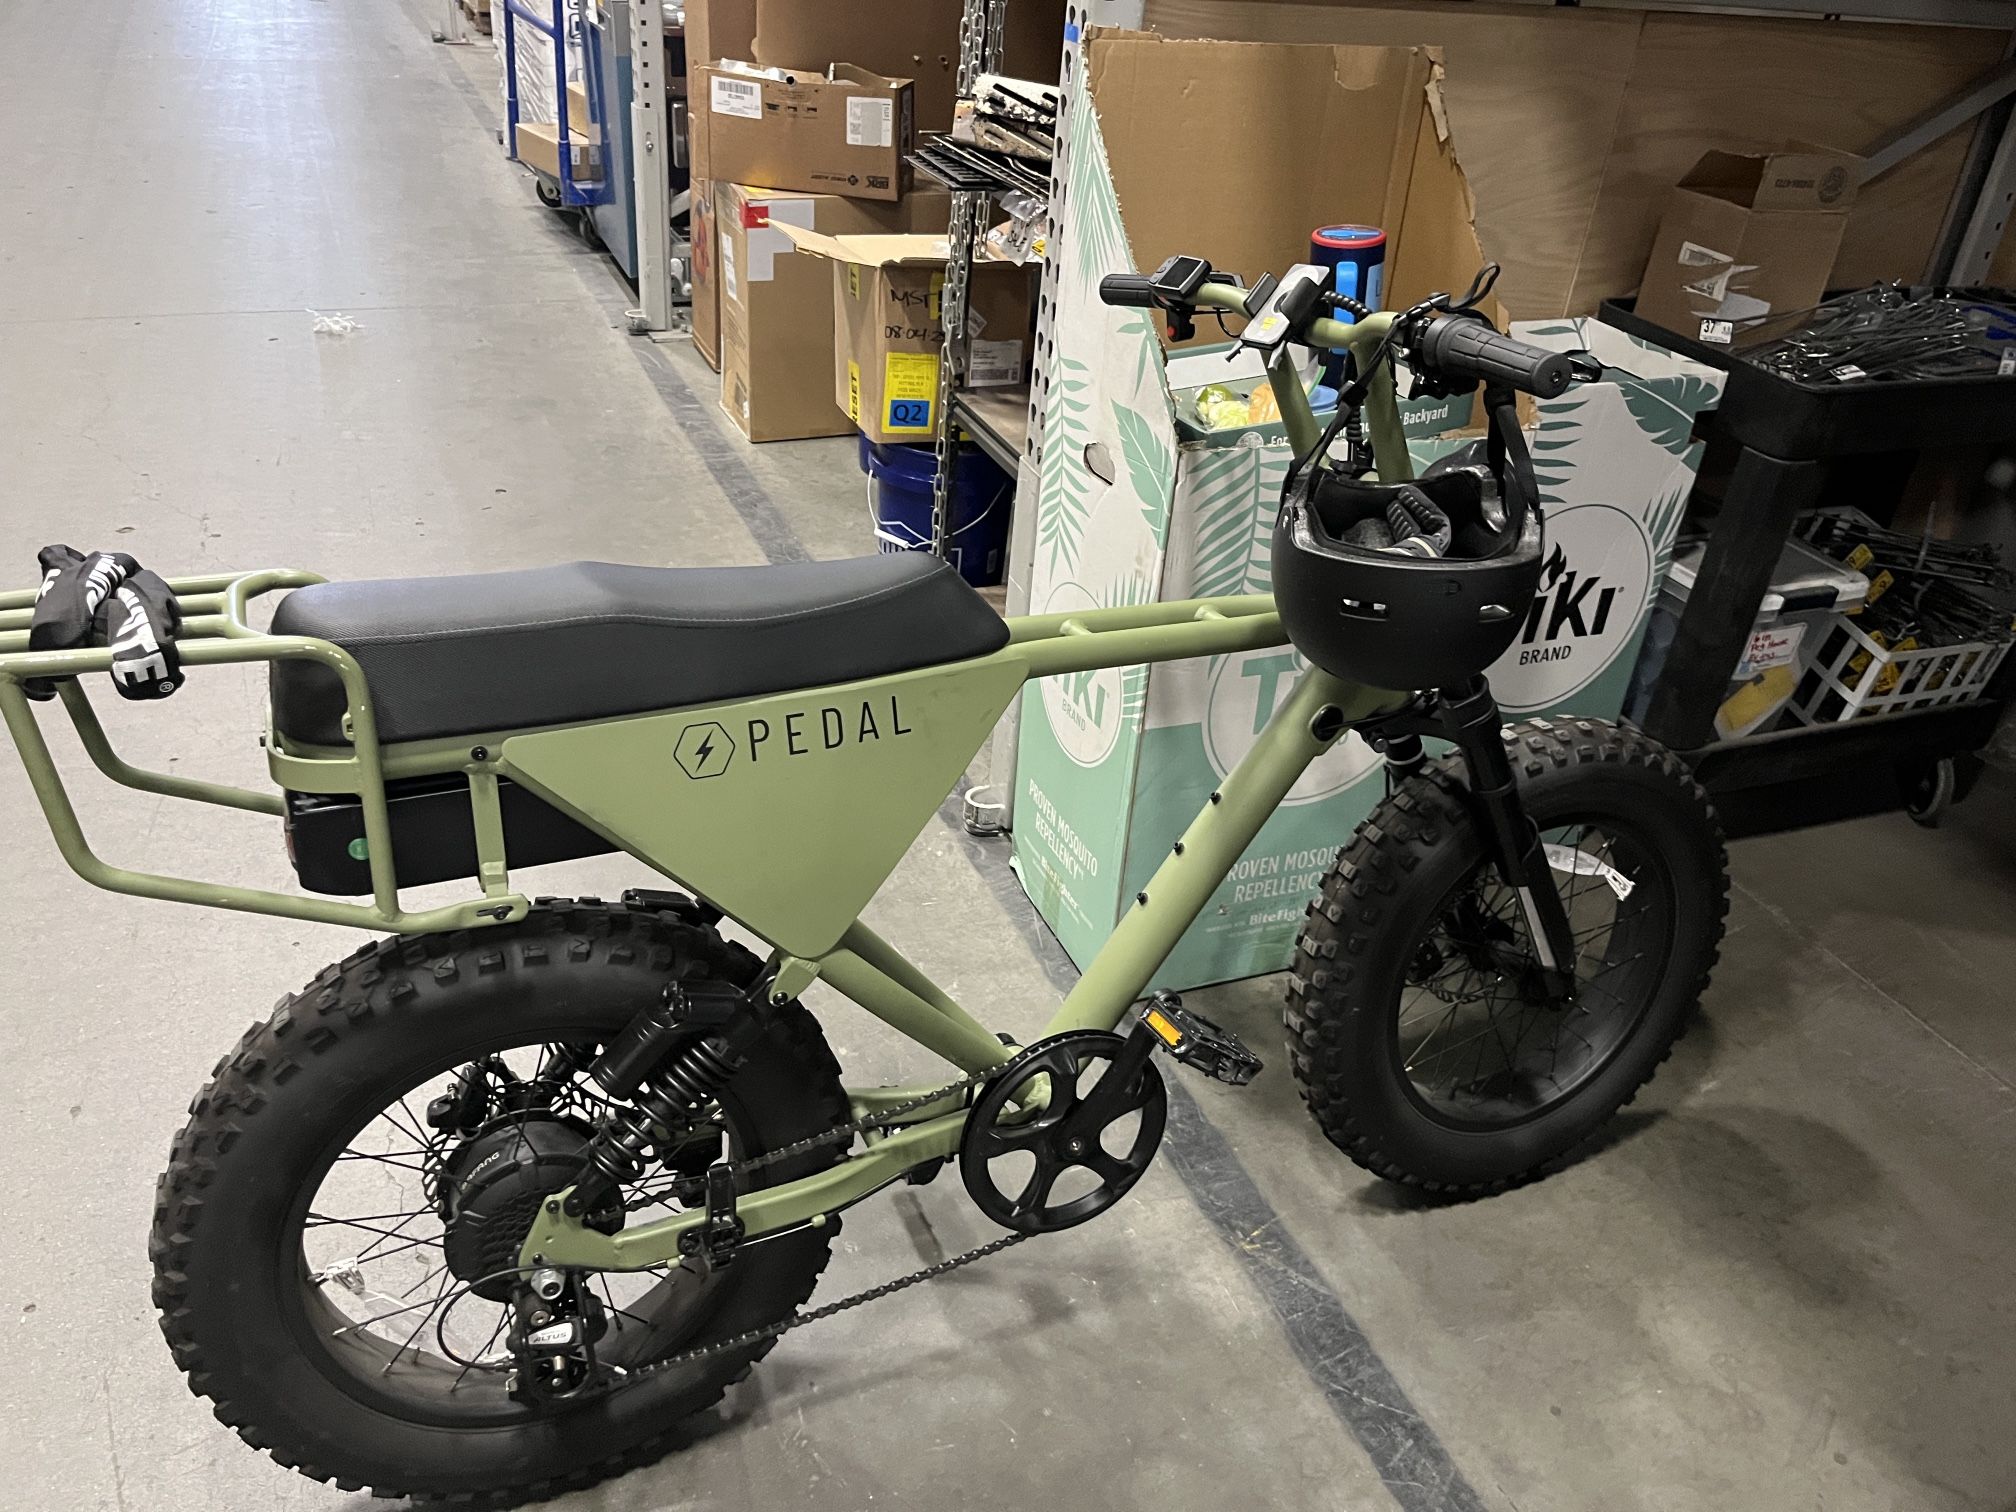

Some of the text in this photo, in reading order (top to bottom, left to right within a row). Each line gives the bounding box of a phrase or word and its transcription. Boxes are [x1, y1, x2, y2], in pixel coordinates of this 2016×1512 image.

[893, 403, 923, 424] Q2
[1403, 404, 1449, 426] Backyard
[1521, 570, 1616, 645] IKI
[1519, 645, 1572, 666] BRAND
[748, 695, 912, 762] PEDAL
[1061, 698, 1086, 732] BRAND
[1028, 778, 1057, 827] PROVEN
[1057, 815, 1098, 877] MOSQUITO
[1226, 845, 1344, 883] ROVEN MOSQU
[533, 1332, 567, 1343] ALTUS
